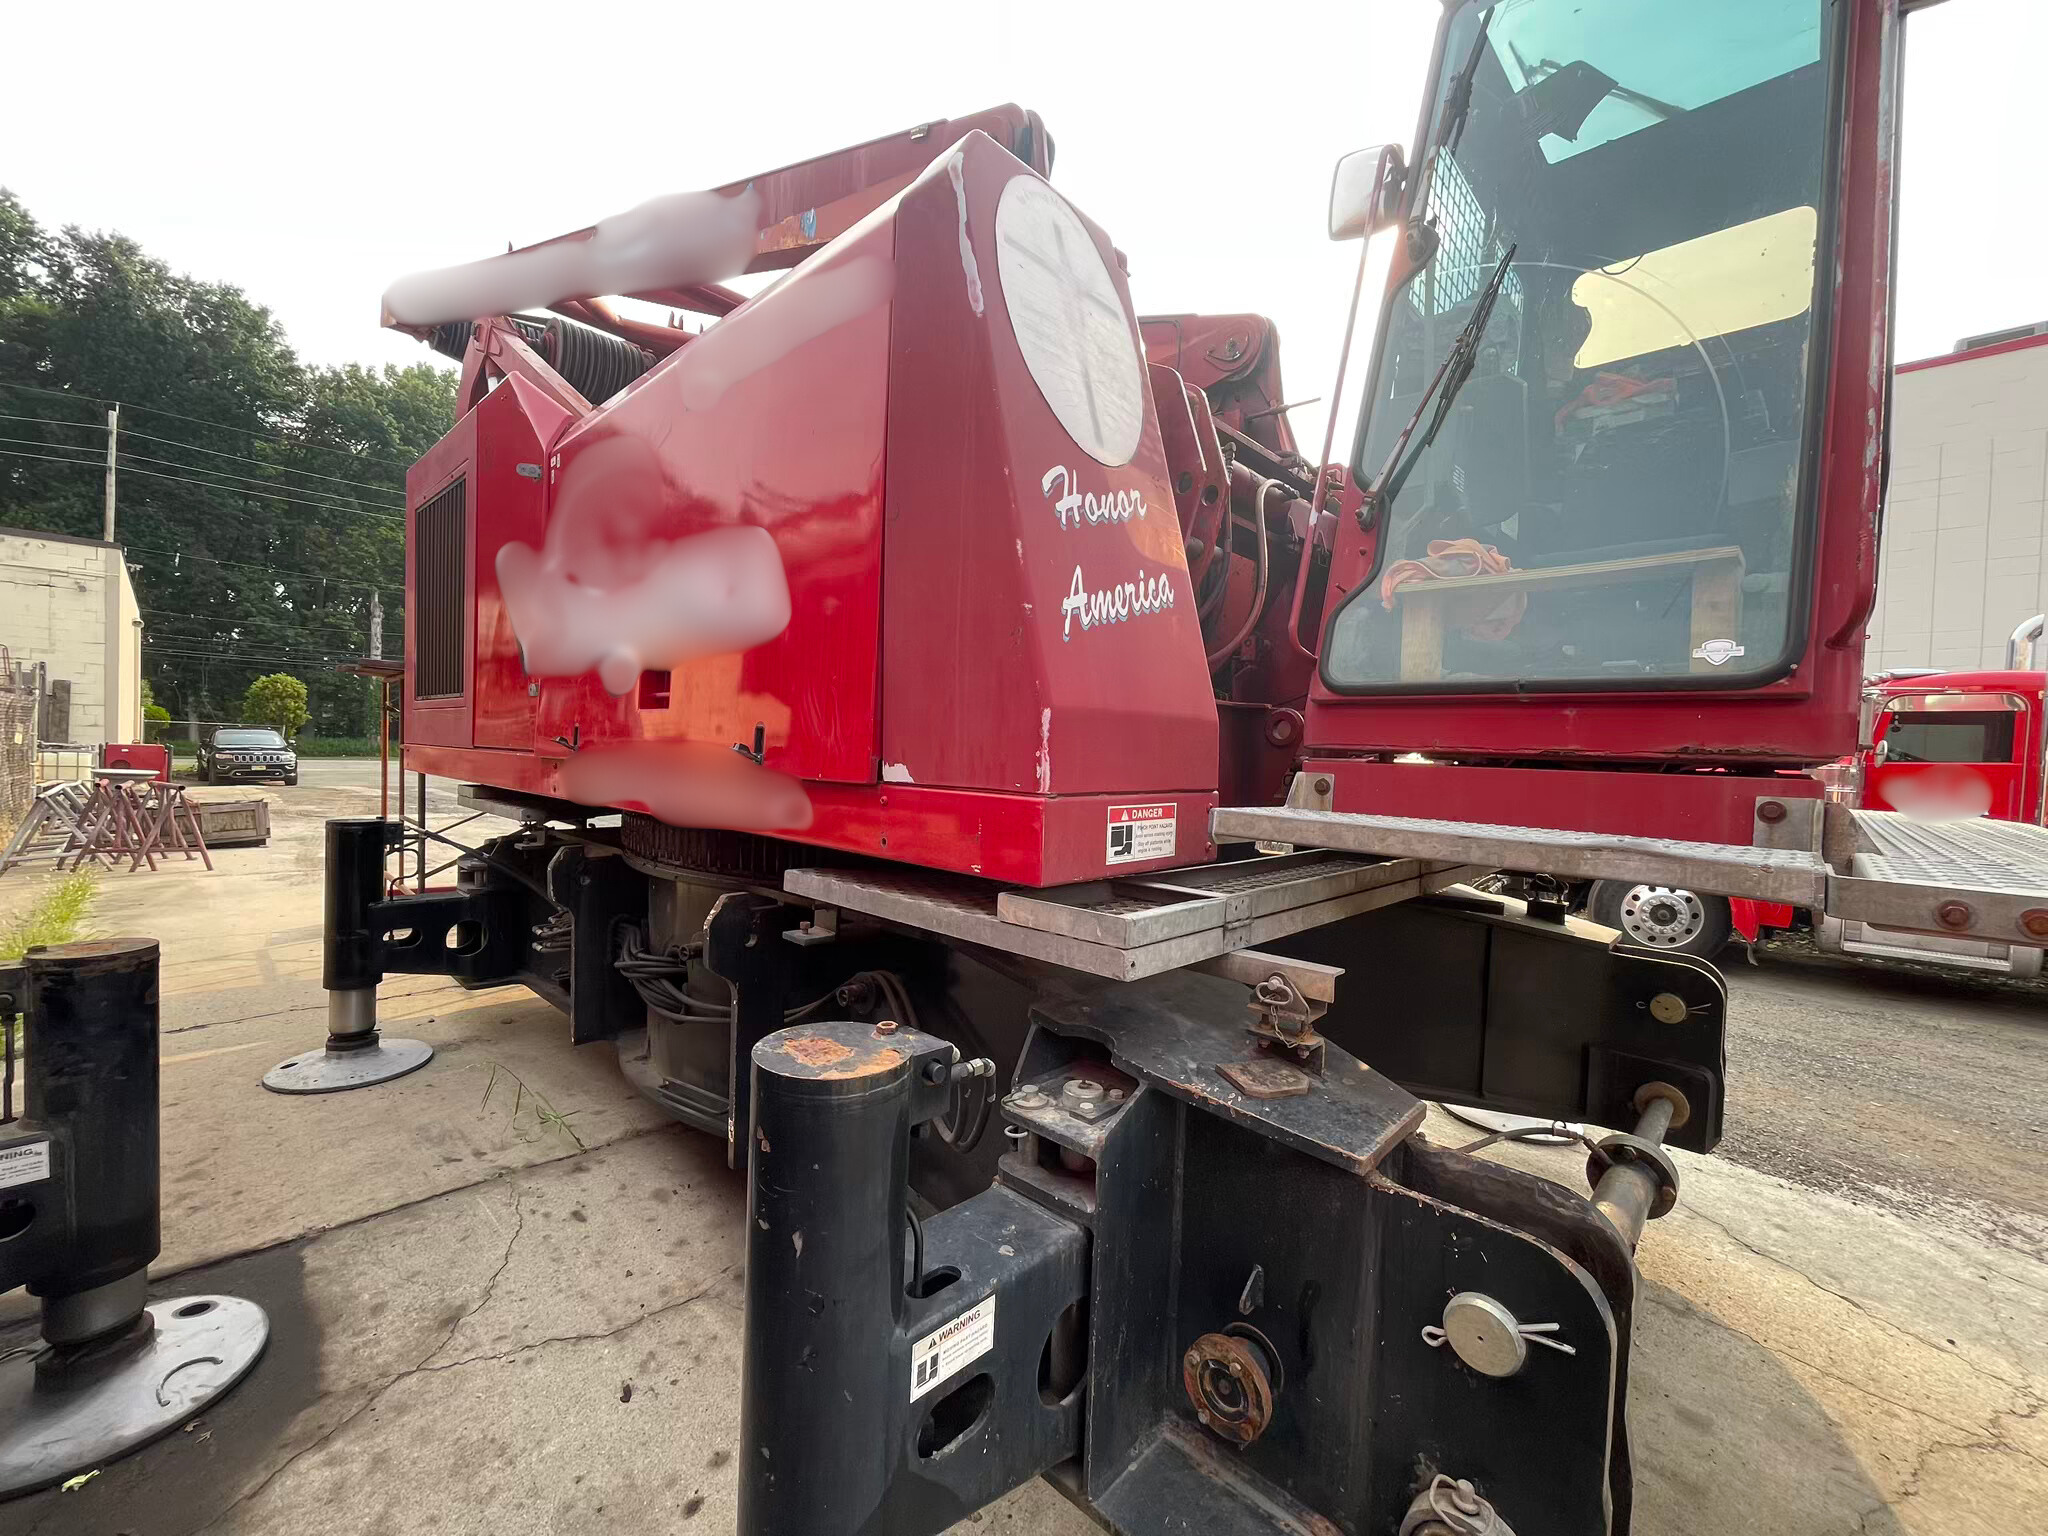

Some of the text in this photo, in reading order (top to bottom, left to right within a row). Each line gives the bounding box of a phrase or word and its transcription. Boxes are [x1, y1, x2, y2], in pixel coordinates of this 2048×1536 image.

[1041, 465, 1147, 528] Honor
[1062, 565, 1174, 641] America
[1132, 808, 1162, 819] DANGER
[938, 1310, 981, 1342] WARNING
